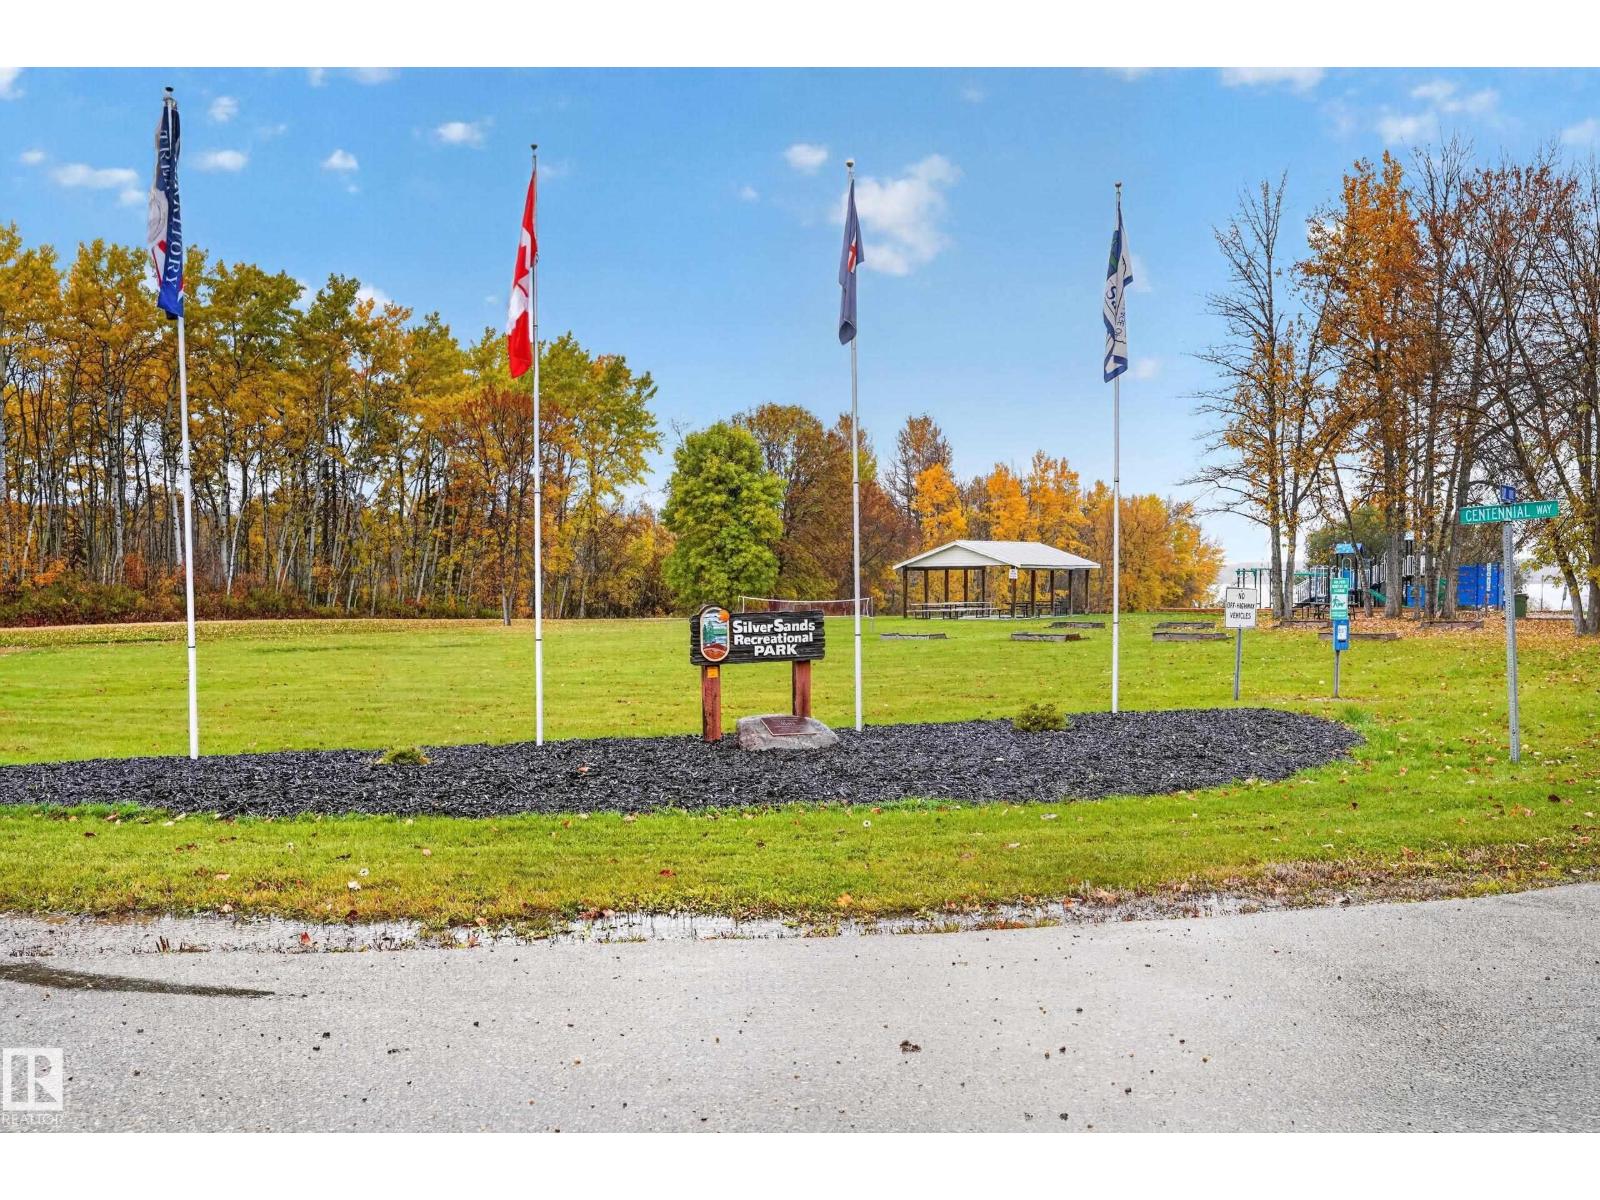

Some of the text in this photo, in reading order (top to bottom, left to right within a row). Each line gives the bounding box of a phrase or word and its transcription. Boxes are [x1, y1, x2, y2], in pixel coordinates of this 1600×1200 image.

[1465, 504, 1552, 522] CENTENNIAL WAY
[1238, 592, 1245, 600] NO
[734, 632, 813, 645] Recreational
[754, 644, 798, 656] PARK
